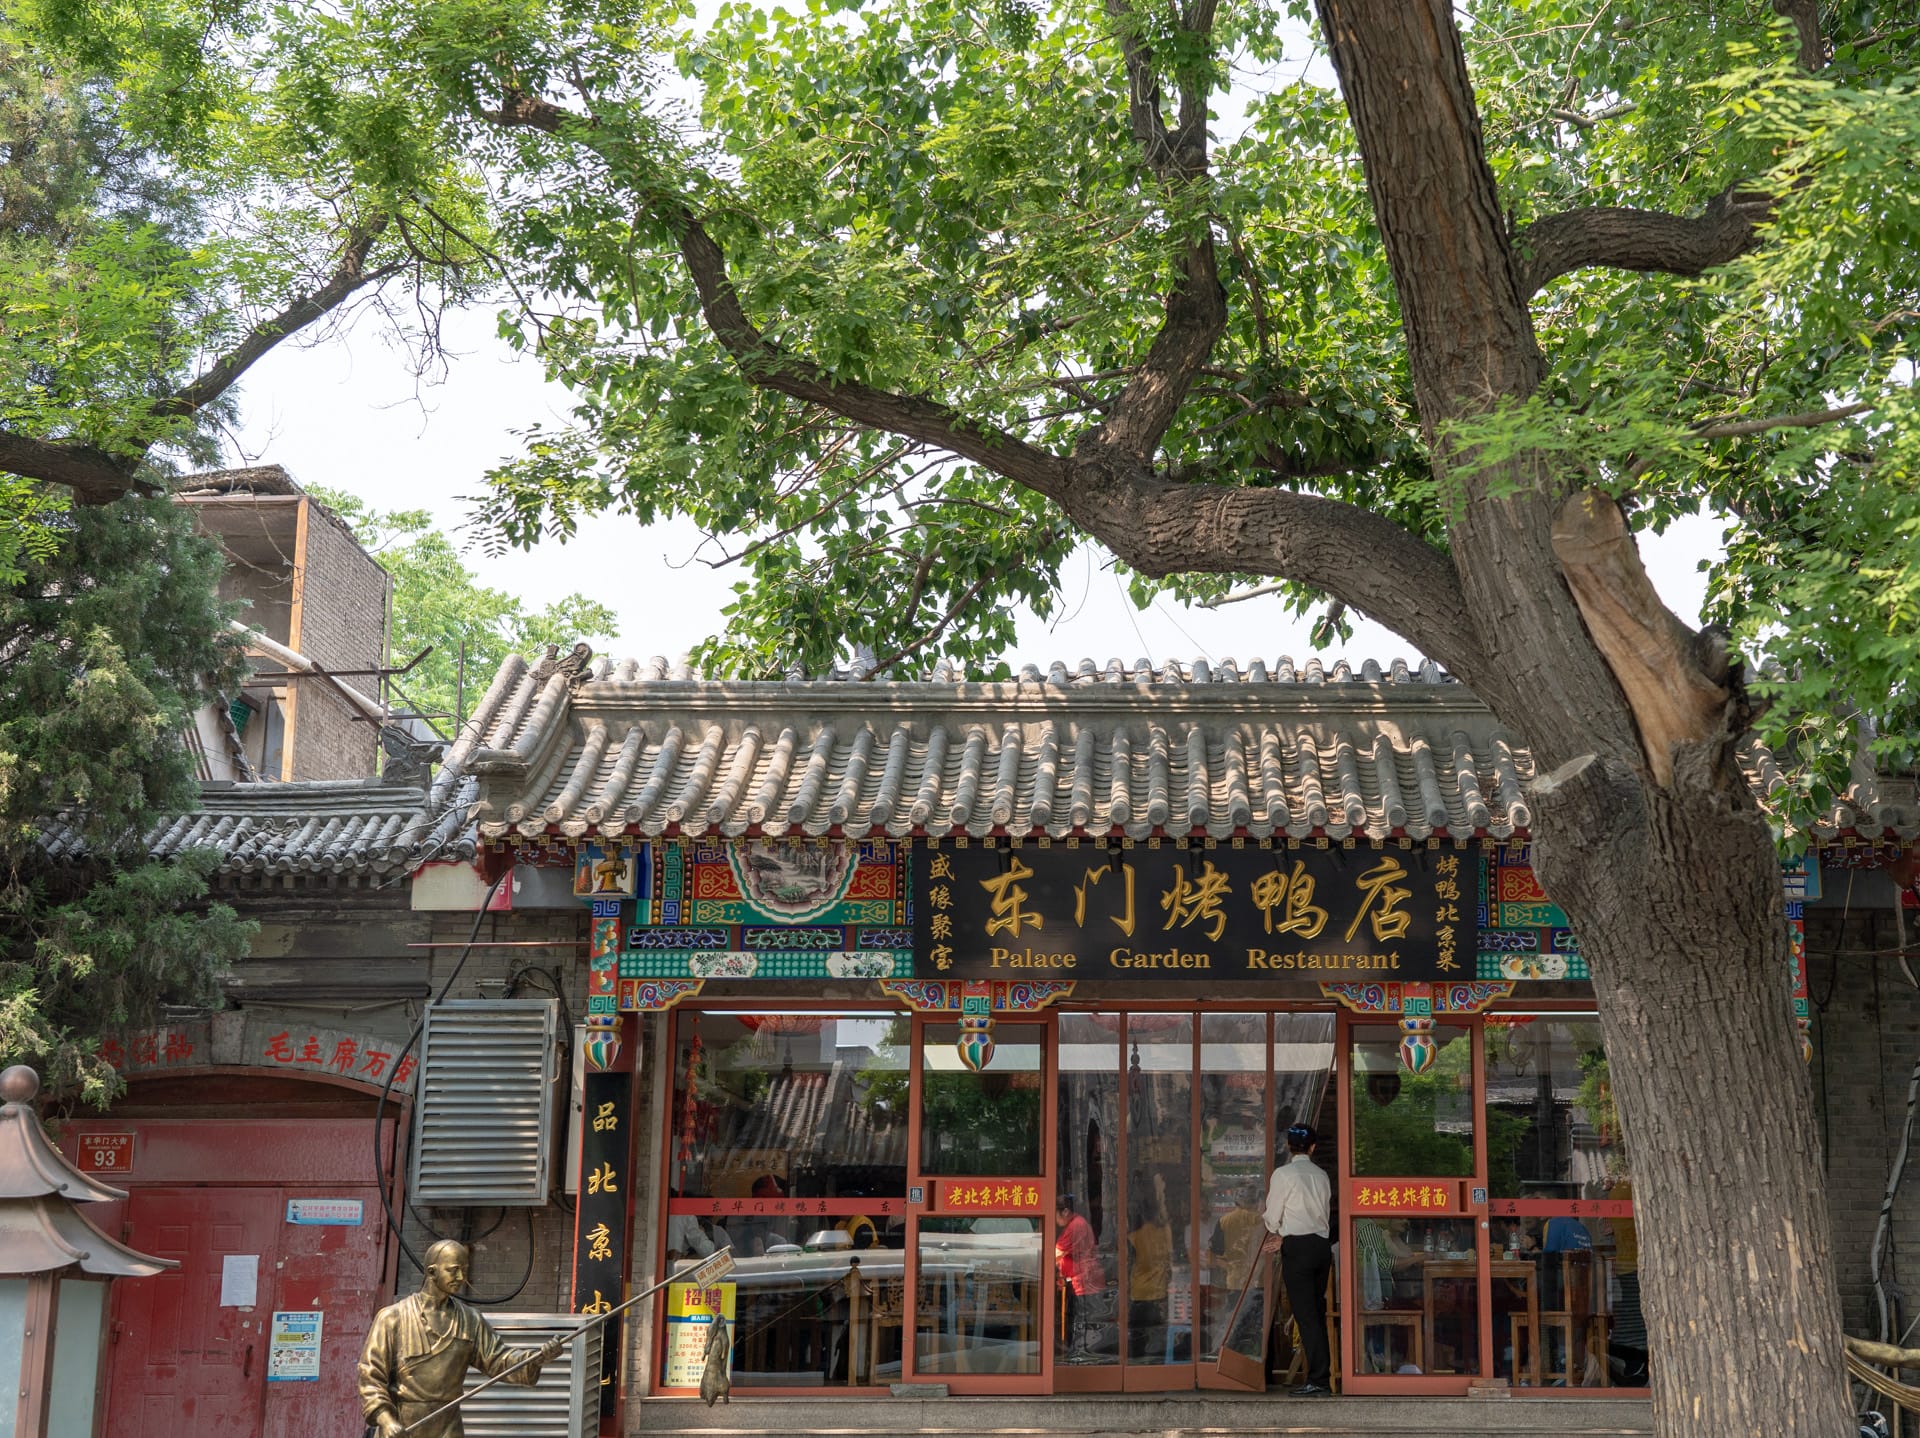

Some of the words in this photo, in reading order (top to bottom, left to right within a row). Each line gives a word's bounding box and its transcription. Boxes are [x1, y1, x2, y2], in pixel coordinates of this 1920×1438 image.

[978, 856, 1413, 944] 东门烤鸭店
[1434, 854, 1461, 972] 烤鸭北京菜
[990, 947, 1077, 968] Palace
[1109, 947, 1212, 969] Garden
[1246, 948, 1401, 970] Restaurant
[95, 1150, 116, 1167] 93
[711, 1200, 828, 1214] 东华门烤鸭店
[582, 1100, 619, 1386] 品北京小
[685, 1287, 722, 1314] 招聘
